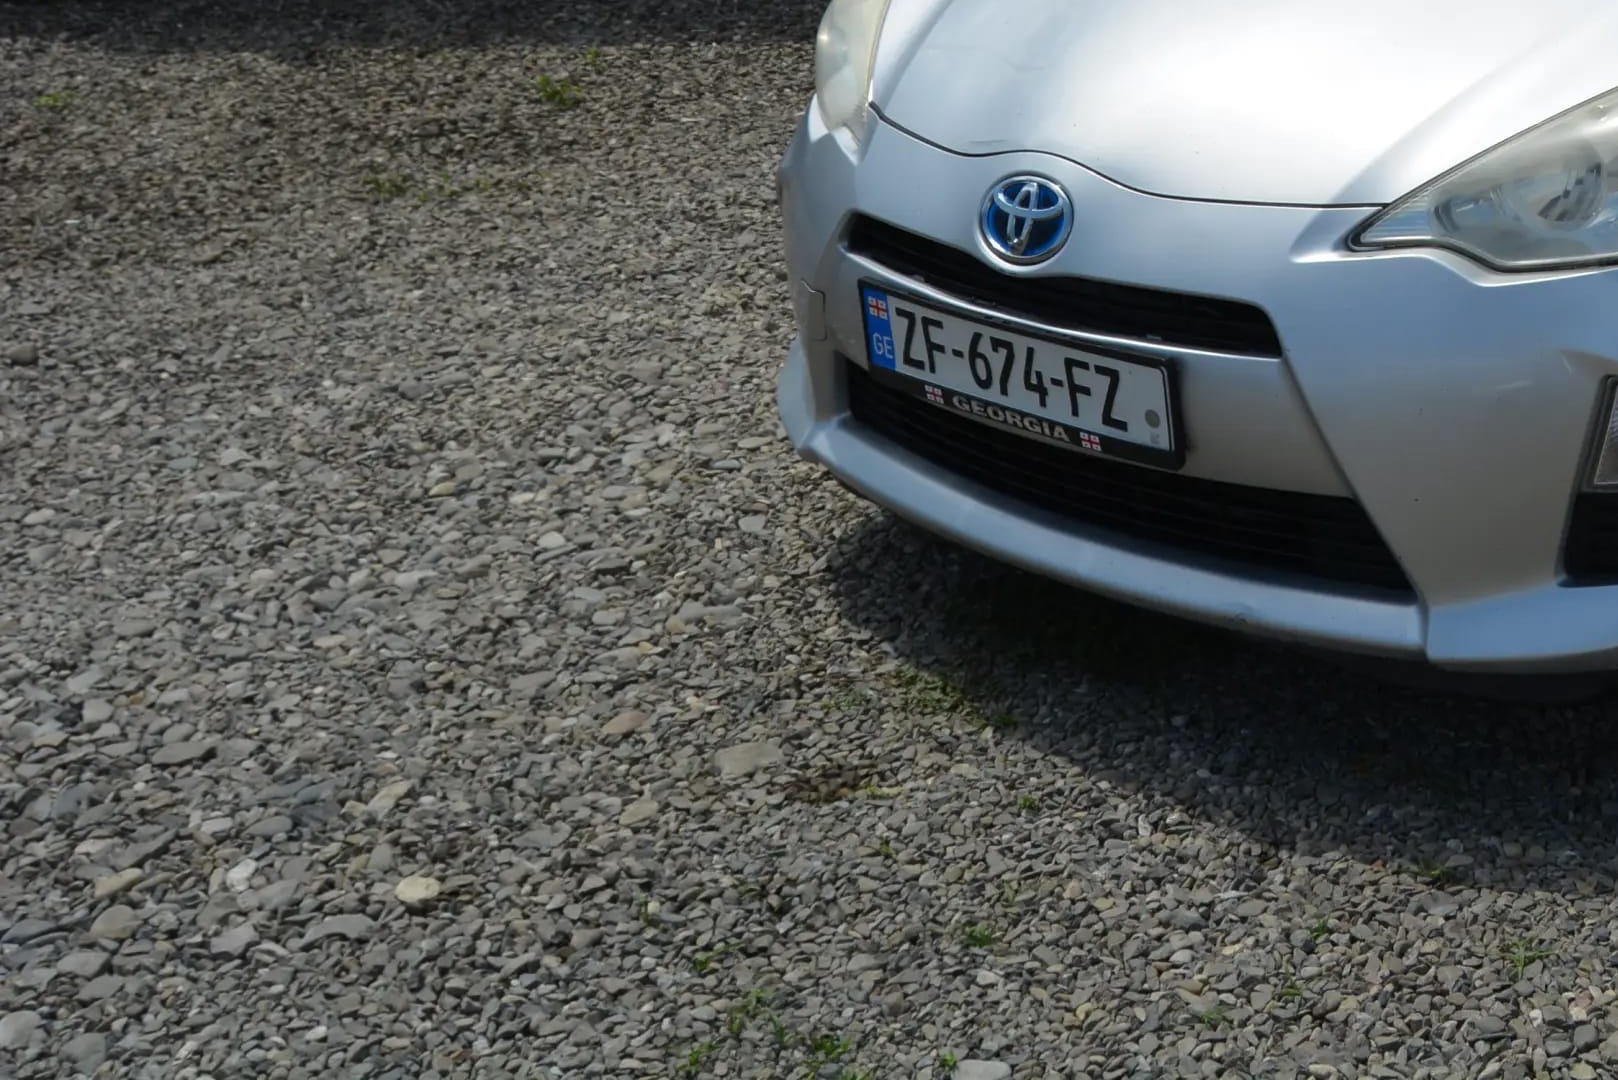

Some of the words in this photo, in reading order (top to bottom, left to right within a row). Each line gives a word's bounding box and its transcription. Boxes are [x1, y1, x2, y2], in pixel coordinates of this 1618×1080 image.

[872, 332, 893, 360] GE
[894, 306, 1128, 433] ZF-674-FZ
[952, 394, 1071, 443] GEORGIA
